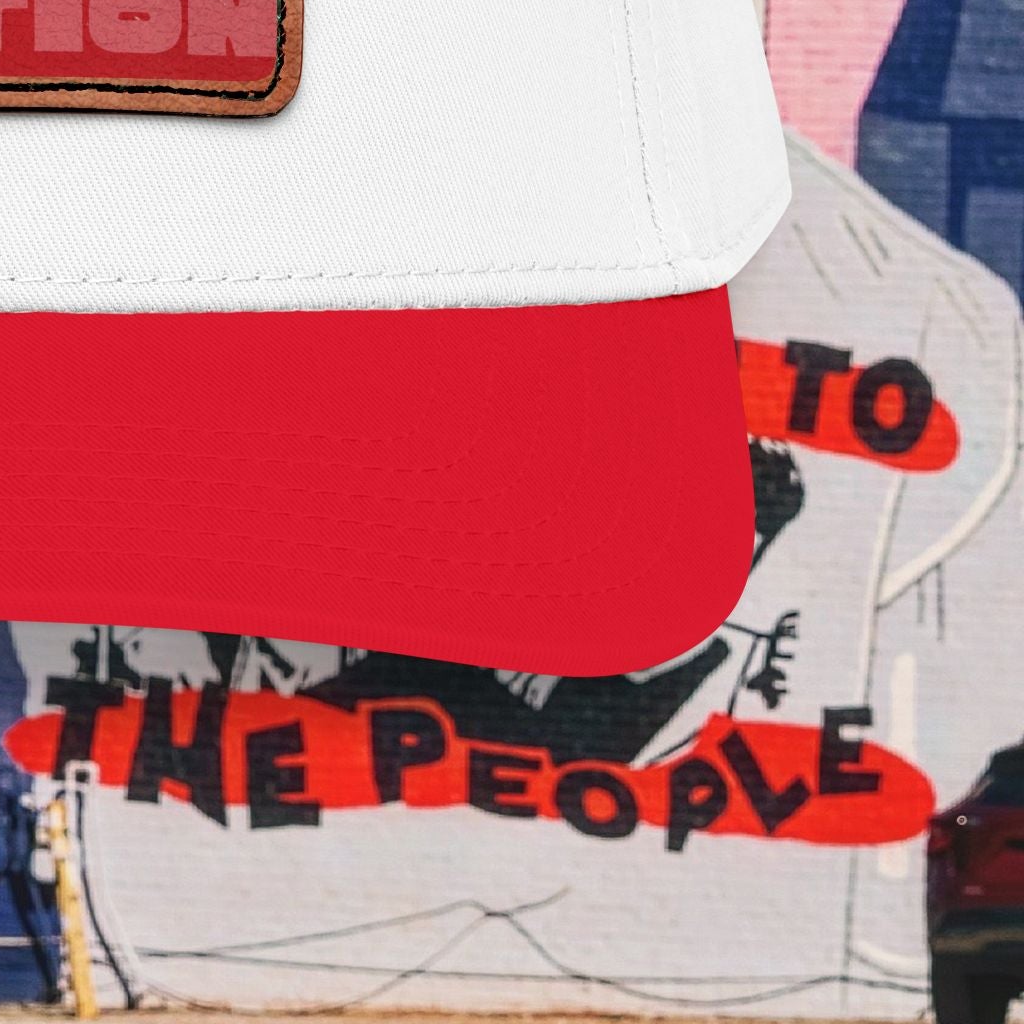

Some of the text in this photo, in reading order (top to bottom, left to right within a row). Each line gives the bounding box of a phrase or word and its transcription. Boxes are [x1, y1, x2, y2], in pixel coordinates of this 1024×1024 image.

[783, 339, 933, 455] TO
[45, 676, 884, 853] THE PEOPLE
